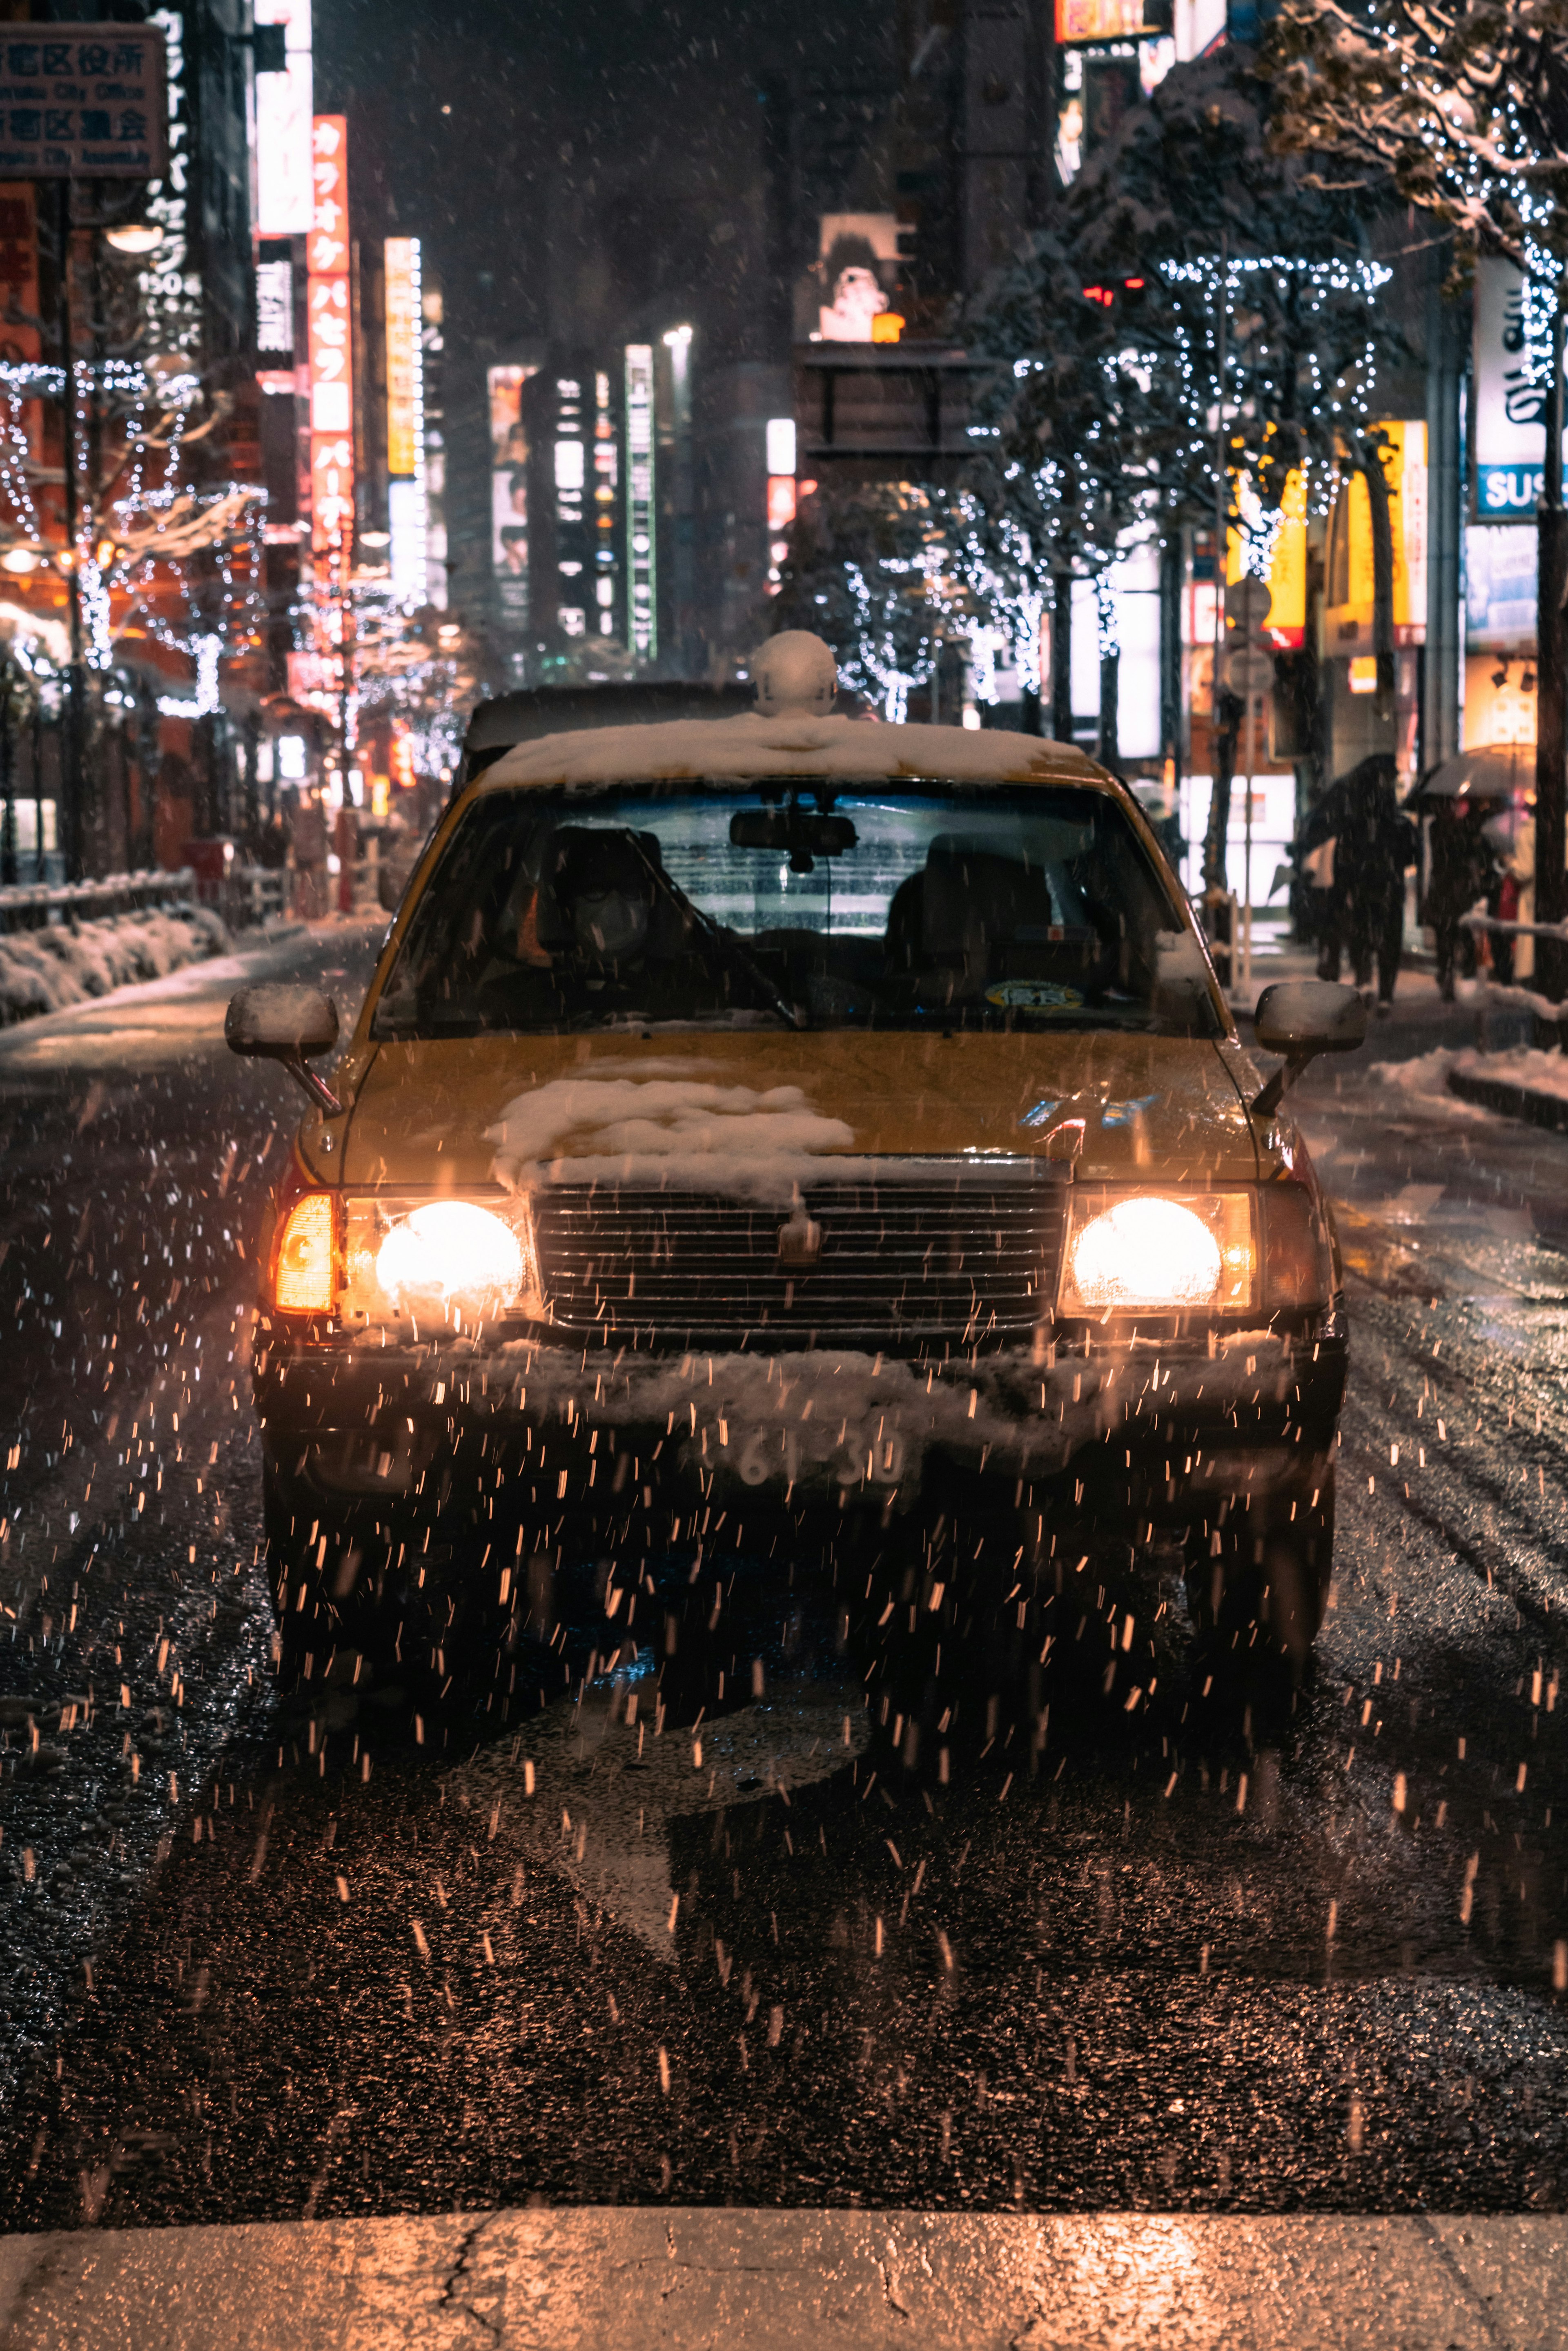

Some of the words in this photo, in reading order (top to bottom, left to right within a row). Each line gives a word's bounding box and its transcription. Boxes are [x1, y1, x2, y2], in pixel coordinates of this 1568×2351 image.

[0, 44, 145, 76] 宿区役所
[0, 108, 146, 141] 宿区会
[312, 122, 345, 270] カラオケ
[312, 280, 347, 382] パセラ
